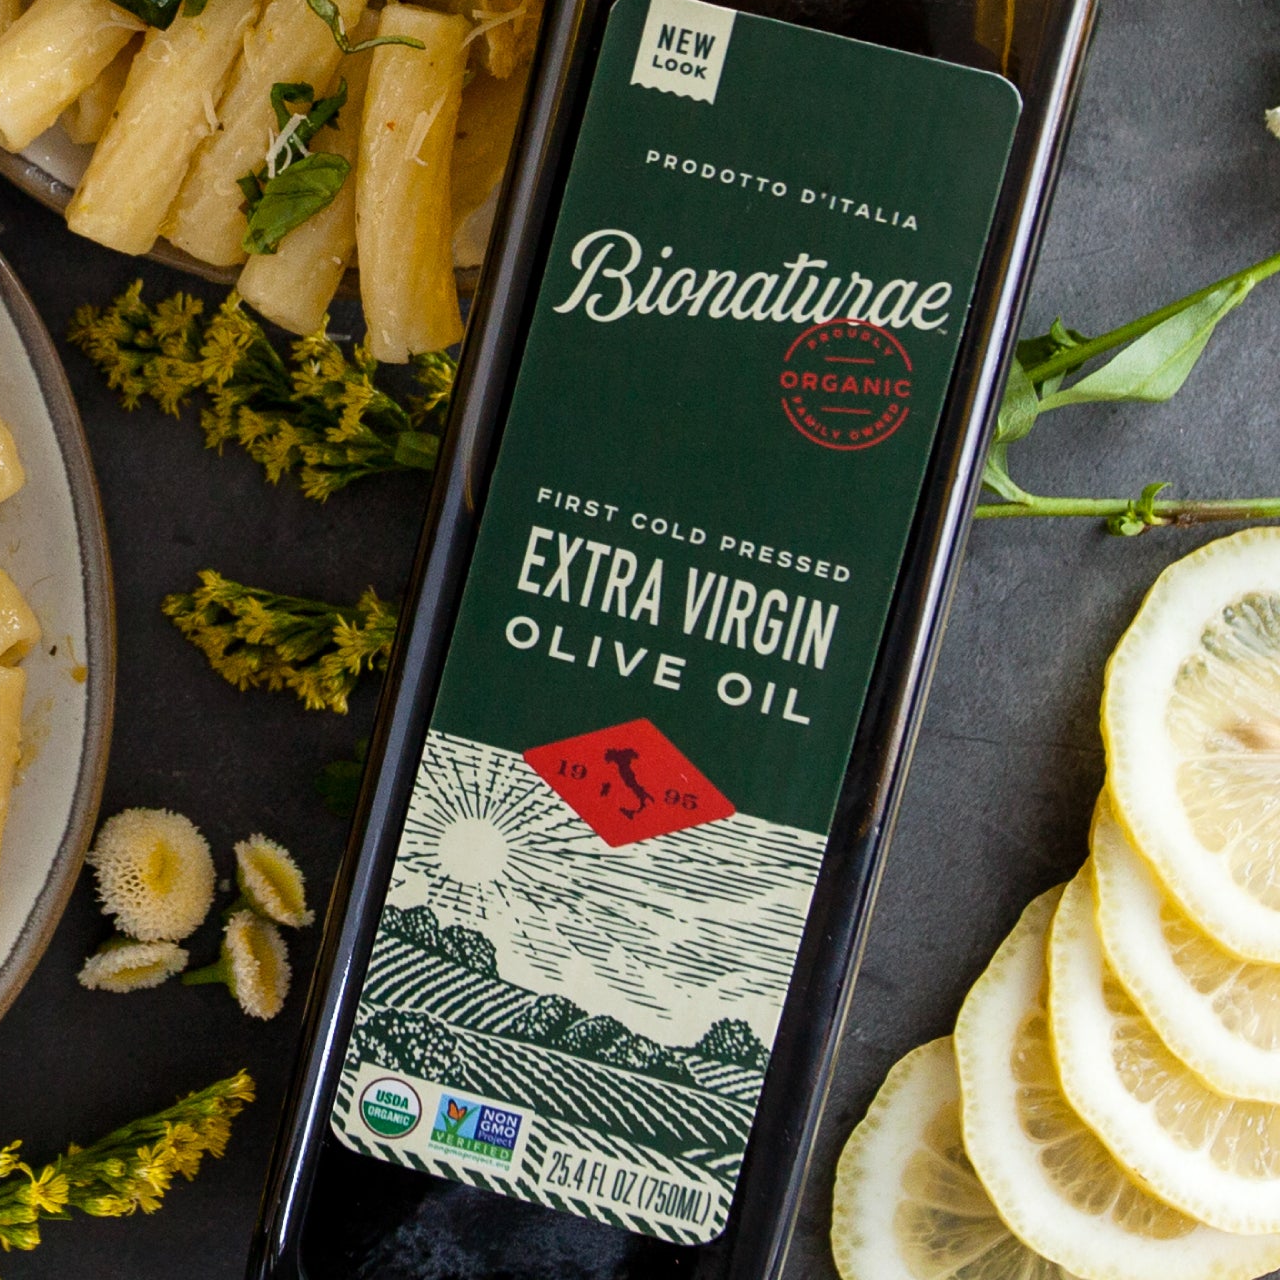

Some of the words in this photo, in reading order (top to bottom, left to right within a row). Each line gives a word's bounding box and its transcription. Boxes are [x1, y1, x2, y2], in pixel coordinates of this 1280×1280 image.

[657, 24, 716, 60] NEW
[652, 54, 708, 80] LOOK
[646, 150, 787, 197] PRODOTTO
[800, 188, 919, 231] D'ITALIA
[552, 228, 953, 331] Bionaturae
[780, 370, 912, 399] ORGANIC
[536, 487, 619, 521] FIRST
[631, 513, 707, 545] COLD
[720, 535, 851, 583] PRESSED
[517, 525, 664, 626] EXTRA
[683, 567, 839, 670] VIRGIN
[505, 615, 687, 691] OLIVE
[717, 672, 810, 725] OIL
[557, 758, 588, 780] 19
[663, 788, 699, 810] 95
[368, 1104, 410, 1127] ORGANIC
[376, 1089, 410, 1110] USDA
[480, 1120, 515, 1139] GMO
[482, 1108, 518, 1128] NON
[436, 1131, 510, 1160] VERIFIED
[478, 1130, 513, 1148] Project
[546, 1150, 587, 1191] 25.4
[587, 1162, 608, 1198] FL
[610, 1169, 639, 1206] OZ
[637, 1175, 712, 1226] (750ML)
